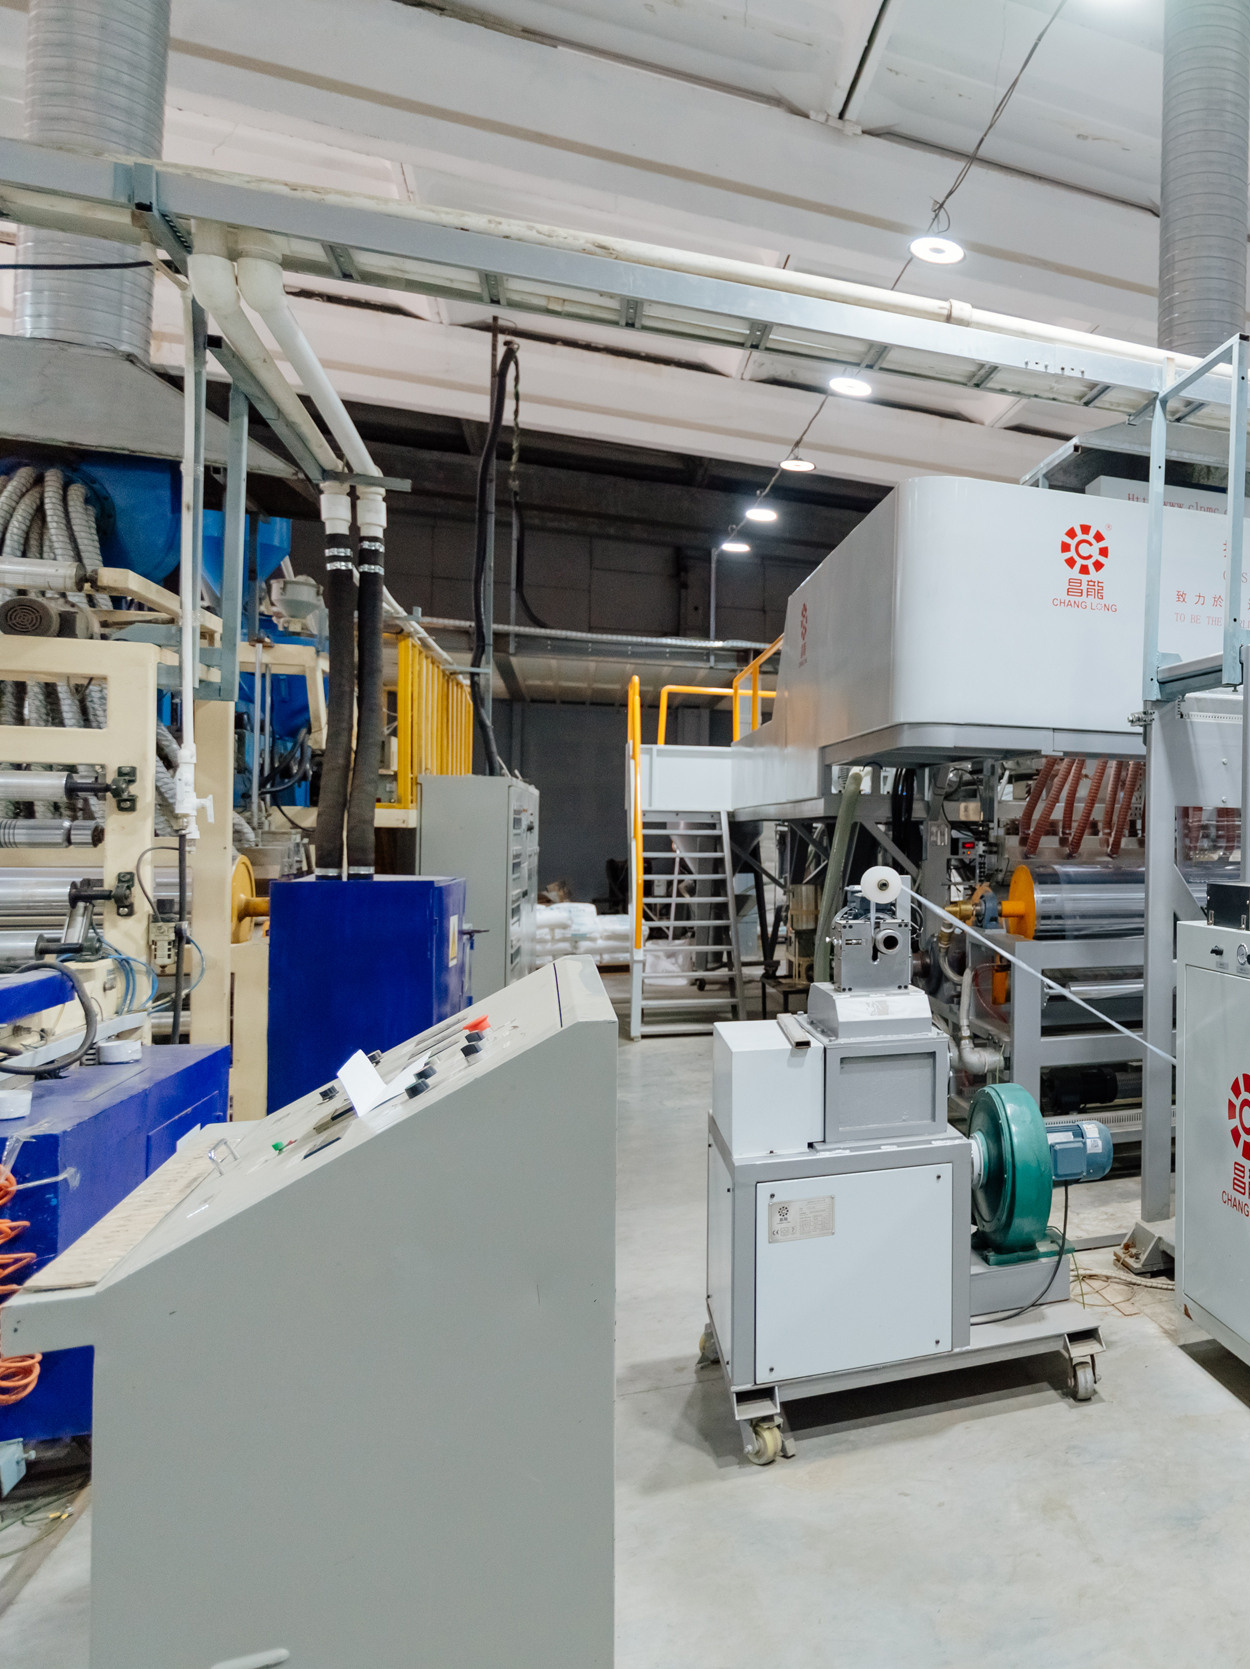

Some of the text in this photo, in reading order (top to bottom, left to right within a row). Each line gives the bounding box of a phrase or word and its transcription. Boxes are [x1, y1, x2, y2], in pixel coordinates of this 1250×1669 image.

[1052, 598, 1118, 613] CHANG LONG
[1174, 612, 1186, 622] TO
[1190, 614, 1201, 625] BE
[1207, 615, 1223, 627] THE
[1222, 1190, 1250, 1217] CHANG
